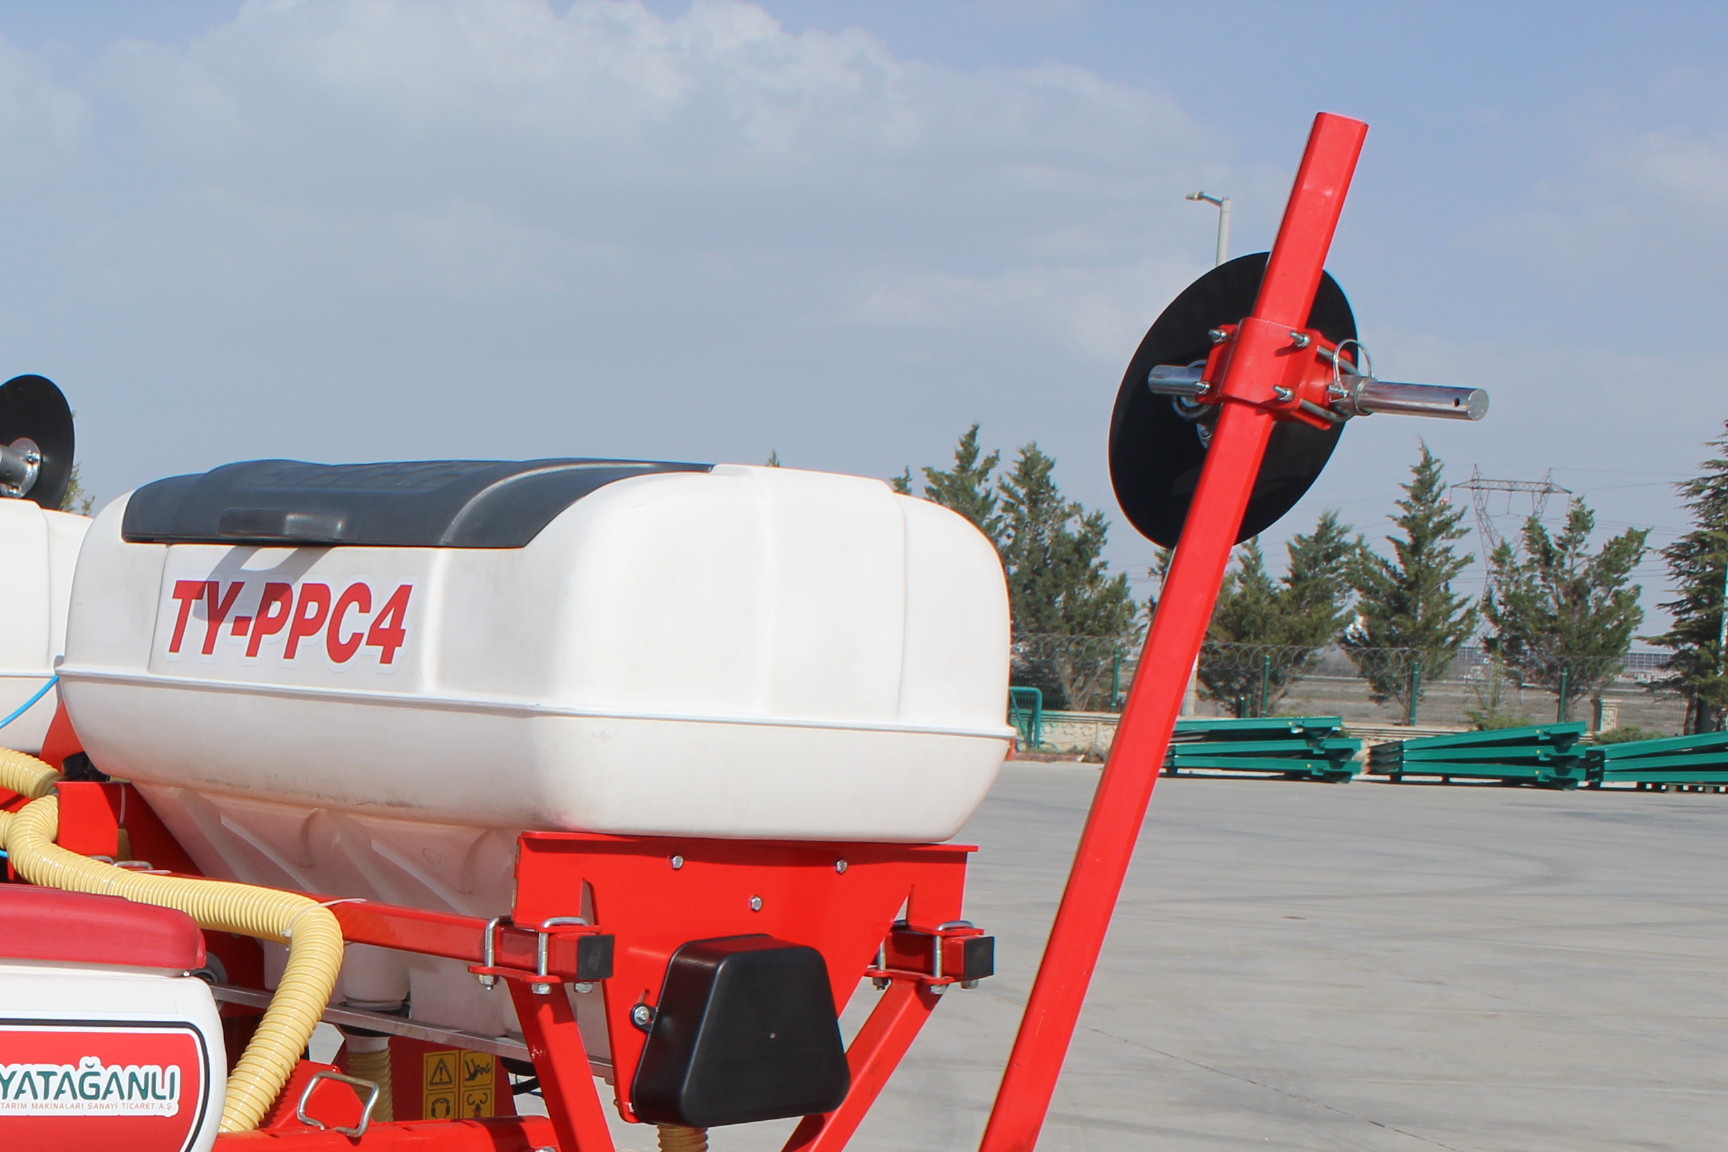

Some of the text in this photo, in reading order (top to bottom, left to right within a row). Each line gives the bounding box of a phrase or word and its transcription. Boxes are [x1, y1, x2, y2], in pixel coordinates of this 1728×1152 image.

[168, 579, 413, 664] TY-PPC4
[0, 1102, 28, 1110] TARIM
[31, 1101, 84, 1110] MAKİNALARI
[87, 1101, 118, 1110] SANAYİ
[121, 1101, 155, 1110] TİCARET
